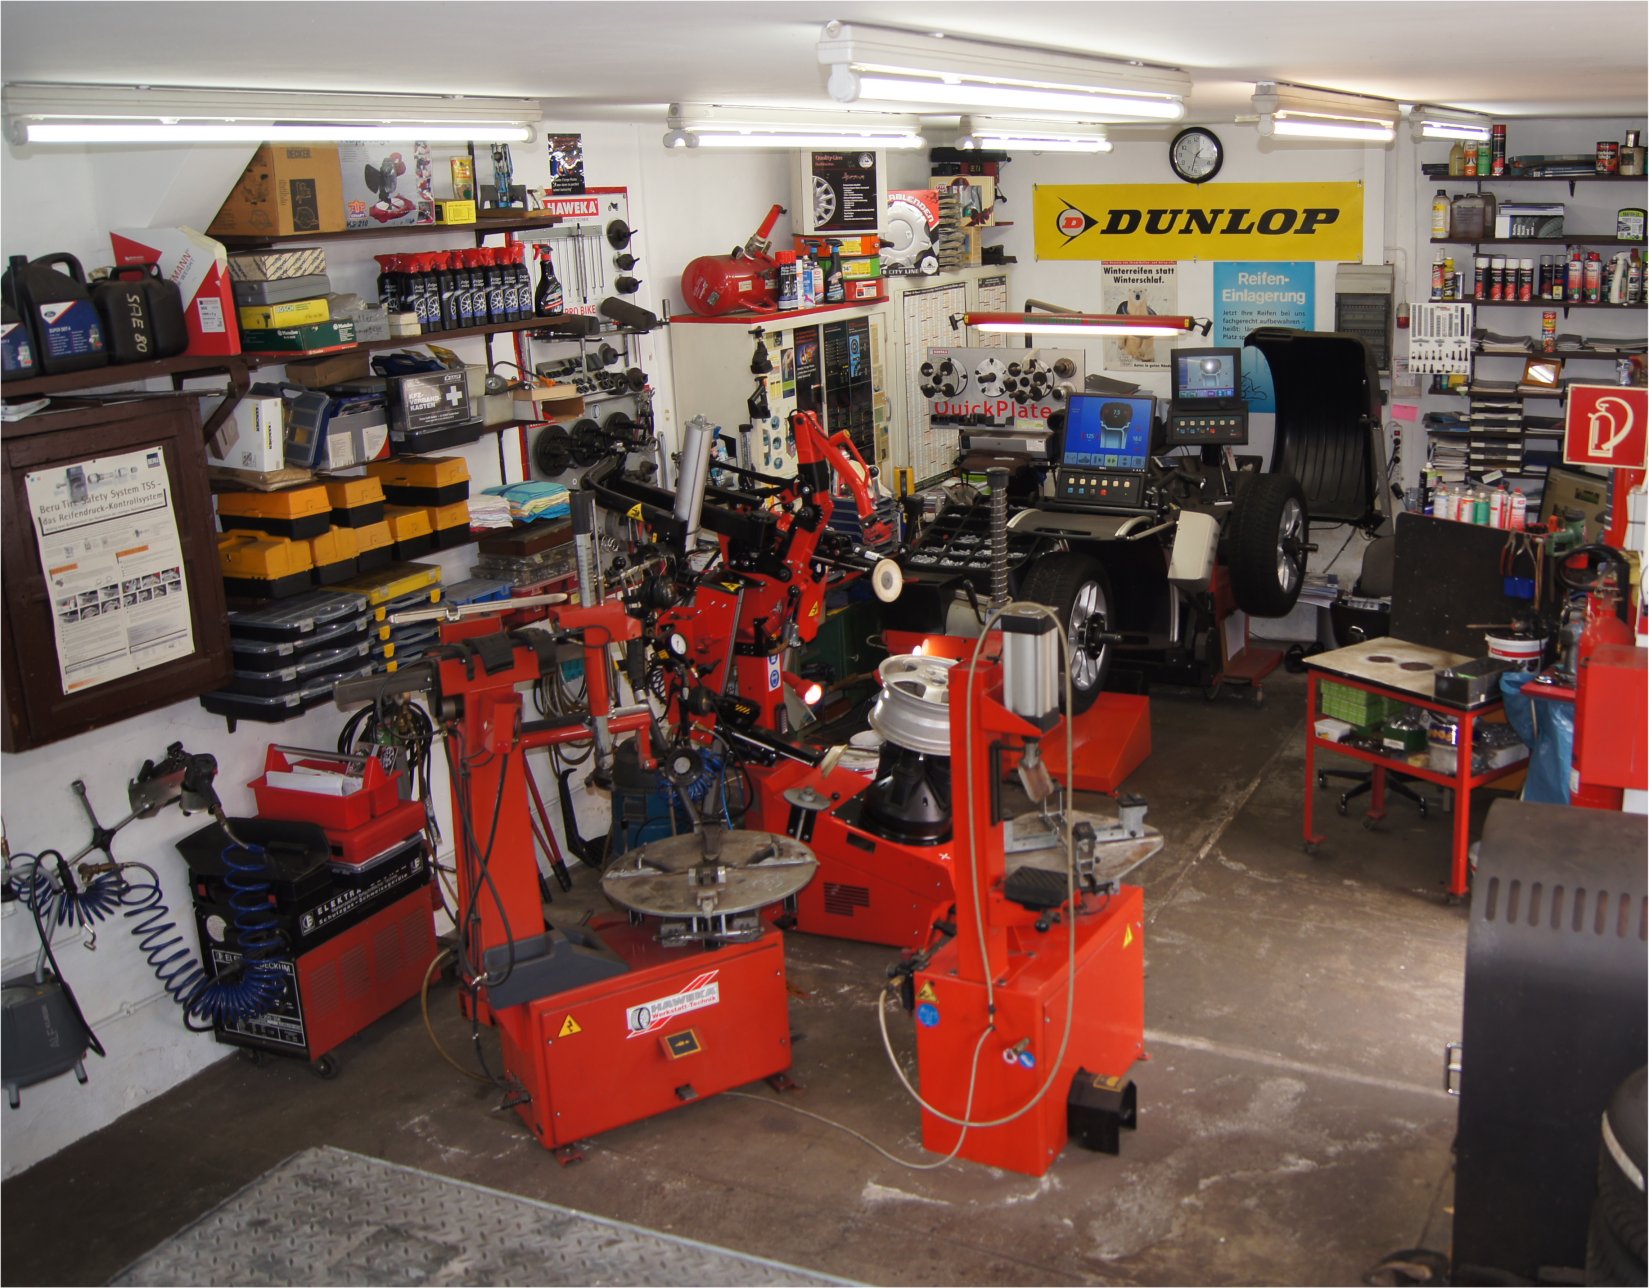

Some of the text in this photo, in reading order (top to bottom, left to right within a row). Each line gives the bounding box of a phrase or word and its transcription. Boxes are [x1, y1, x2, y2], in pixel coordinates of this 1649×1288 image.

[547, 200, 597, 214] HAWEKA
[1062, 216, 1084, 229] D
[1100, 208, 1340, 235] DUNLOP
[1103, 267, 1175, 275] Winterreifen statt
[1238, 271, 1290, 285] Reifen-
[1113, 276, 1165, 284] Winterschlaf.
[1222, 289, 1306, 305] Einlagerung
[580, 304, 596, 315] BIKE
[126, 293, 148, 353] SAE 80
[410, 402, 436, 411] KASTEN
[934, 400, 1053, 419] QuickPlate
[39, 502, 60, 514] Beru
[81, 492, 108, 506] Safety
[110, 486, 139, 499] System
[142, 481, 156, 491] TSS
[42, 492, 163, 526] das Reifendruck-Kontrollsystem
